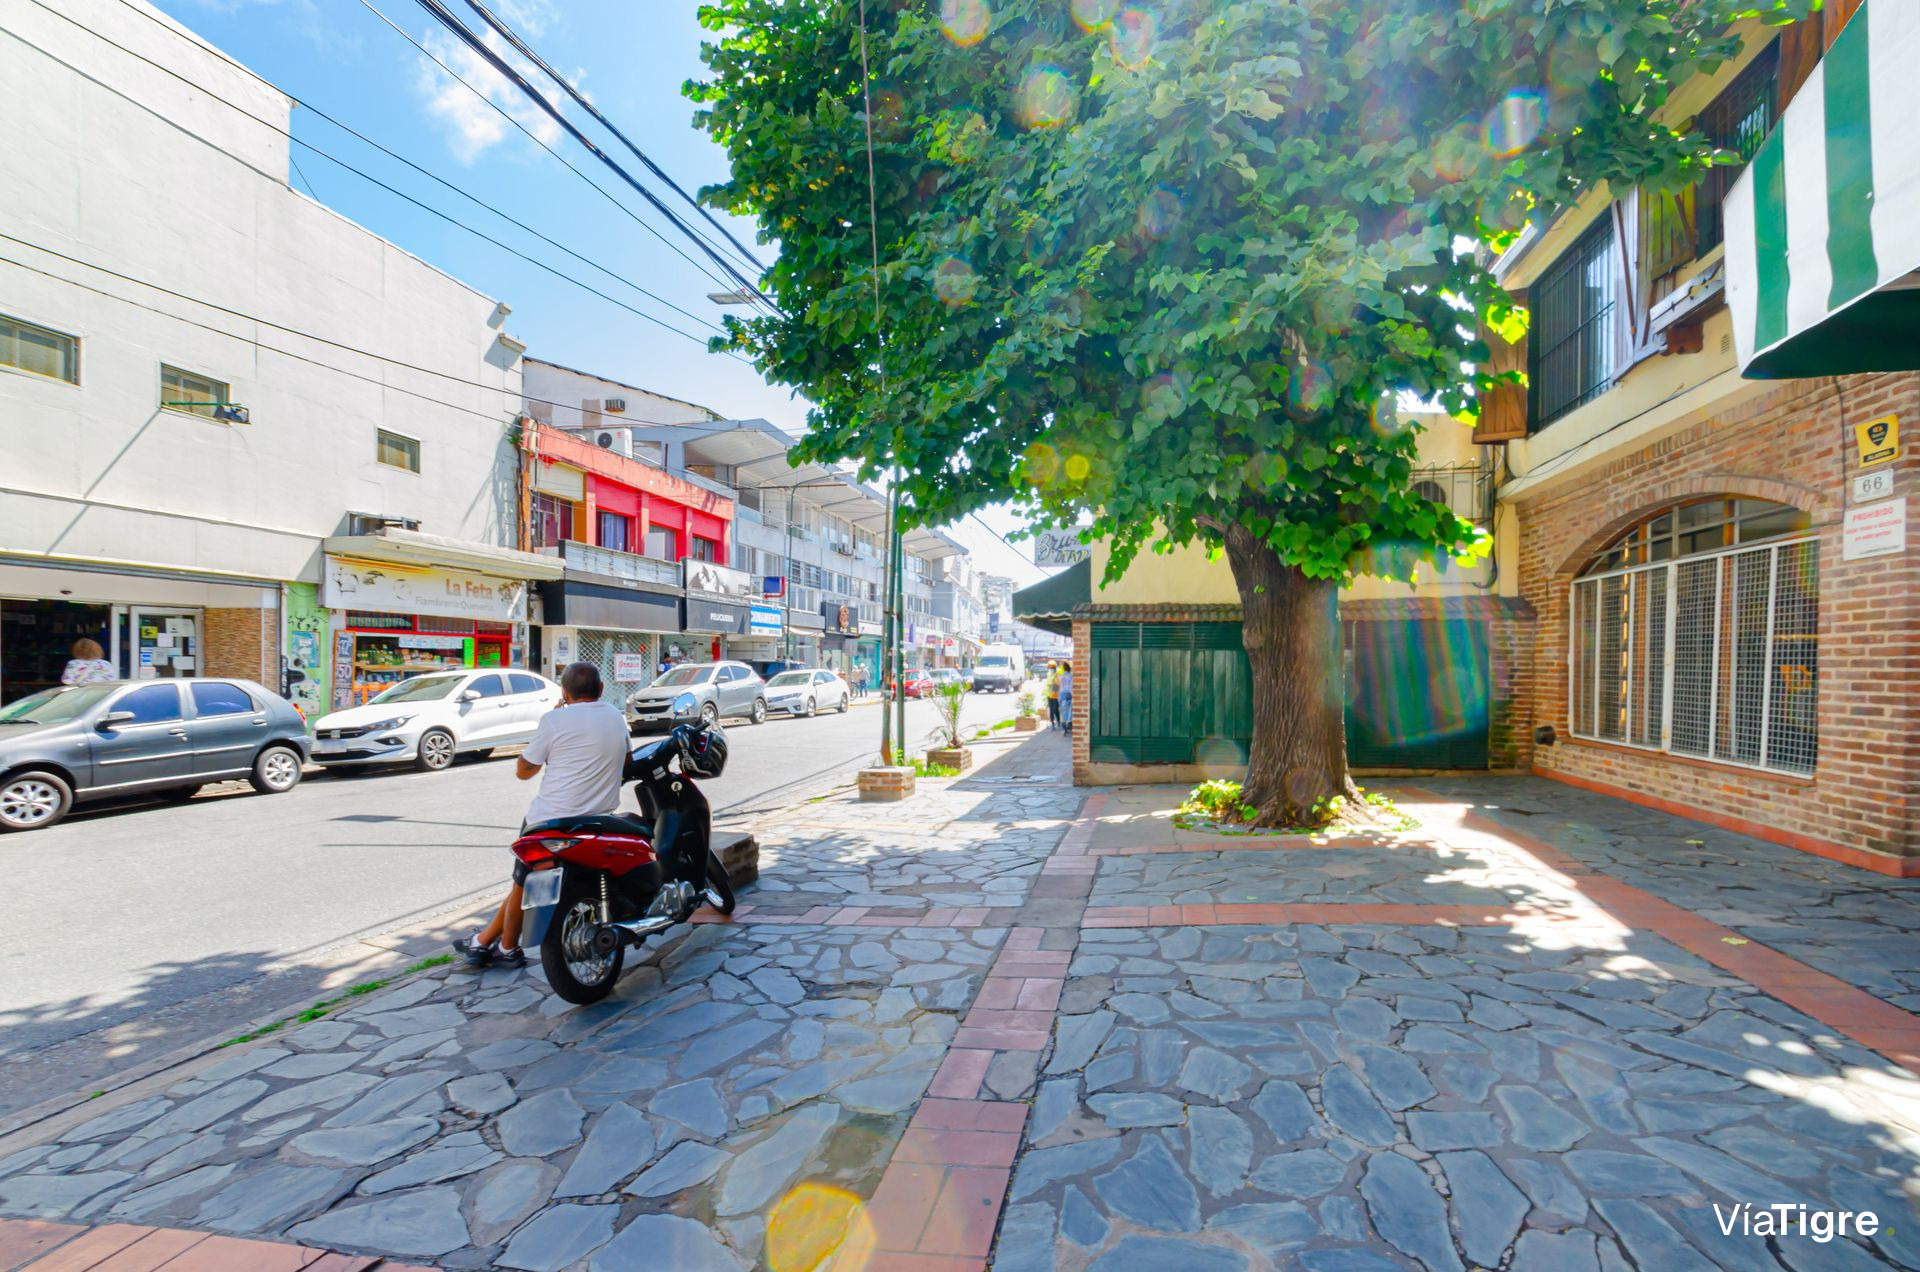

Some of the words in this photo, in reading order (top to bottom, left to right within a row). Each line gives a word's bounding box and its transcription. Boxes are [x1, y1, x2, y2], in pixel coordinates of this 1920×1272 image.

[1863, 476, 1883, 493] 66
[446, 579, 460, 596] La
[465, 579, 493, 600] Feta
